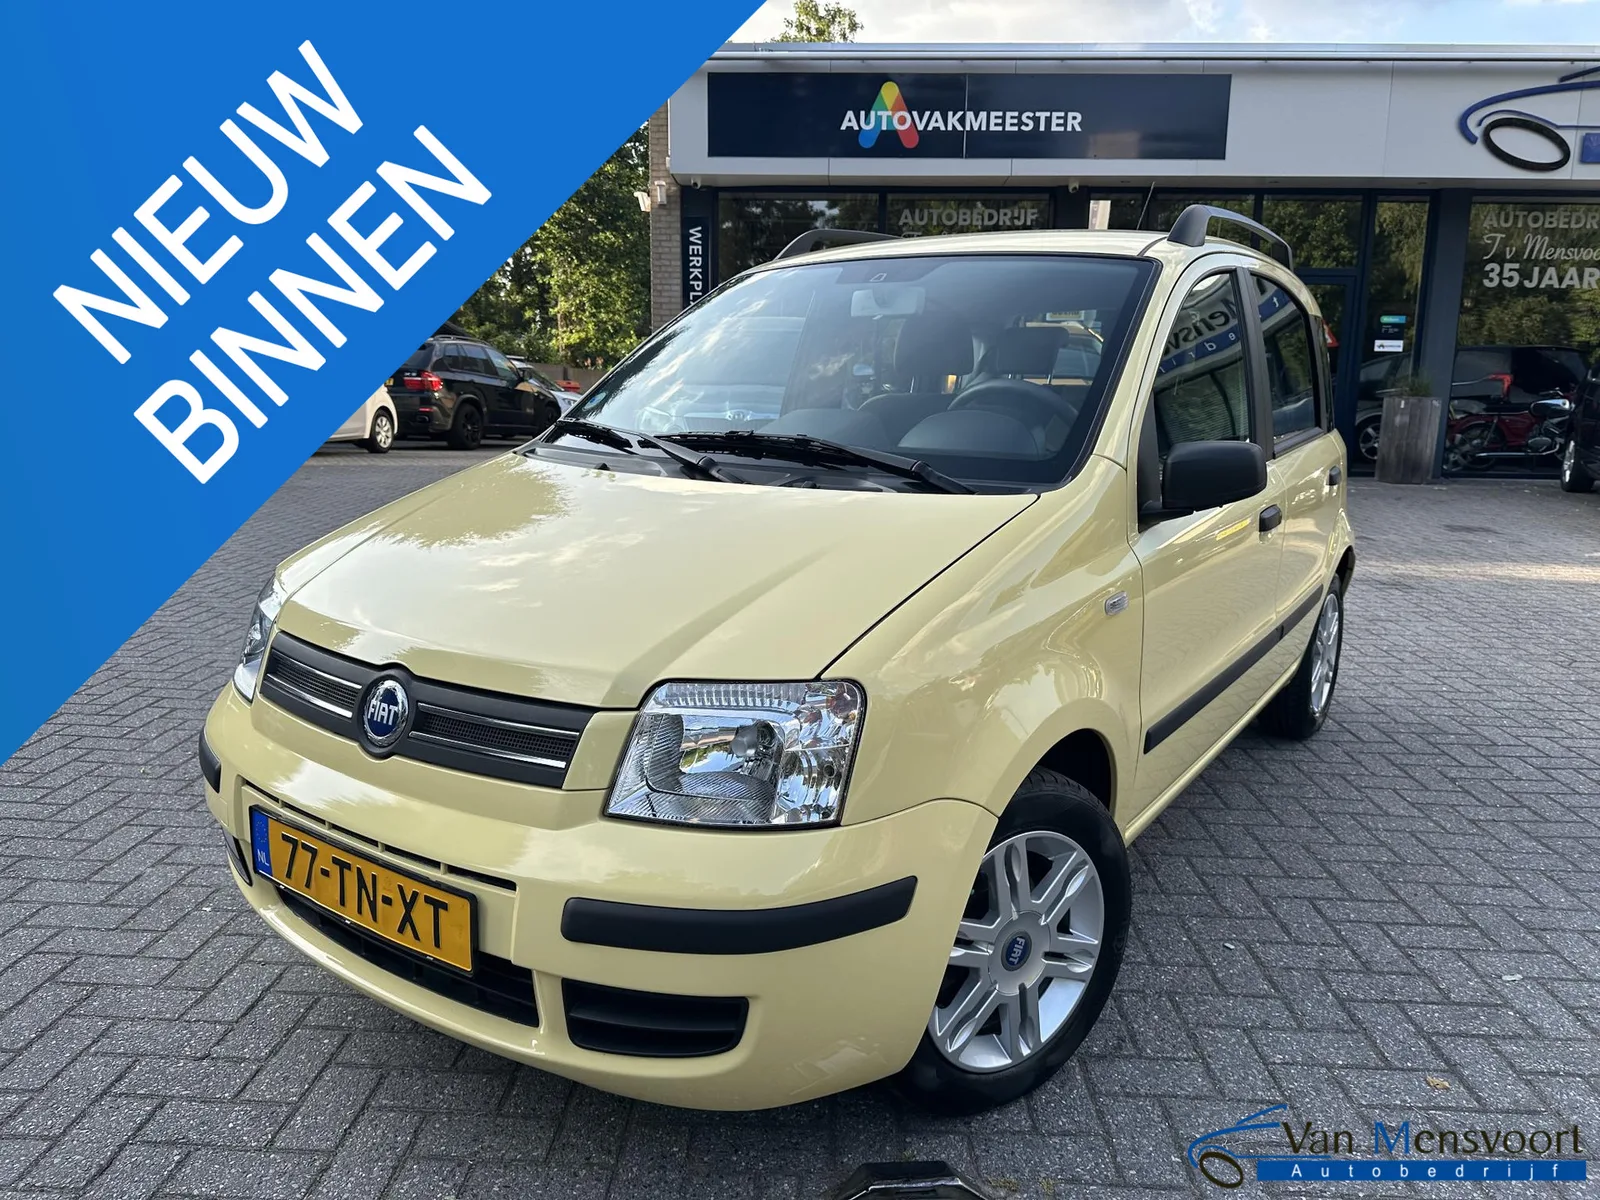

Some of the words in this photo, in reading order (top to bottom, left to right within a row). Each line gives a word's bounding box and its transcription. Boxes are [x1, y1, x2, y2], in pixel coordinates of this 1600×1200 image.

[840, 109, 1083, 133] AUTOVAKMEESTER
[899, 208, 1039, 227] AUTOBEDRIJF
[1483, 233, 1506, 260] T
[1483, 263, 1520, 288] 35
[1523, 266, 1600, 289] JAAR
[367, 699, 400, 726] FIAT
[257, 849, 270, 866] NL
[280, 831, 449, 949] 77-TN-XT
[1009, 937, 1026, 965] FIAT
